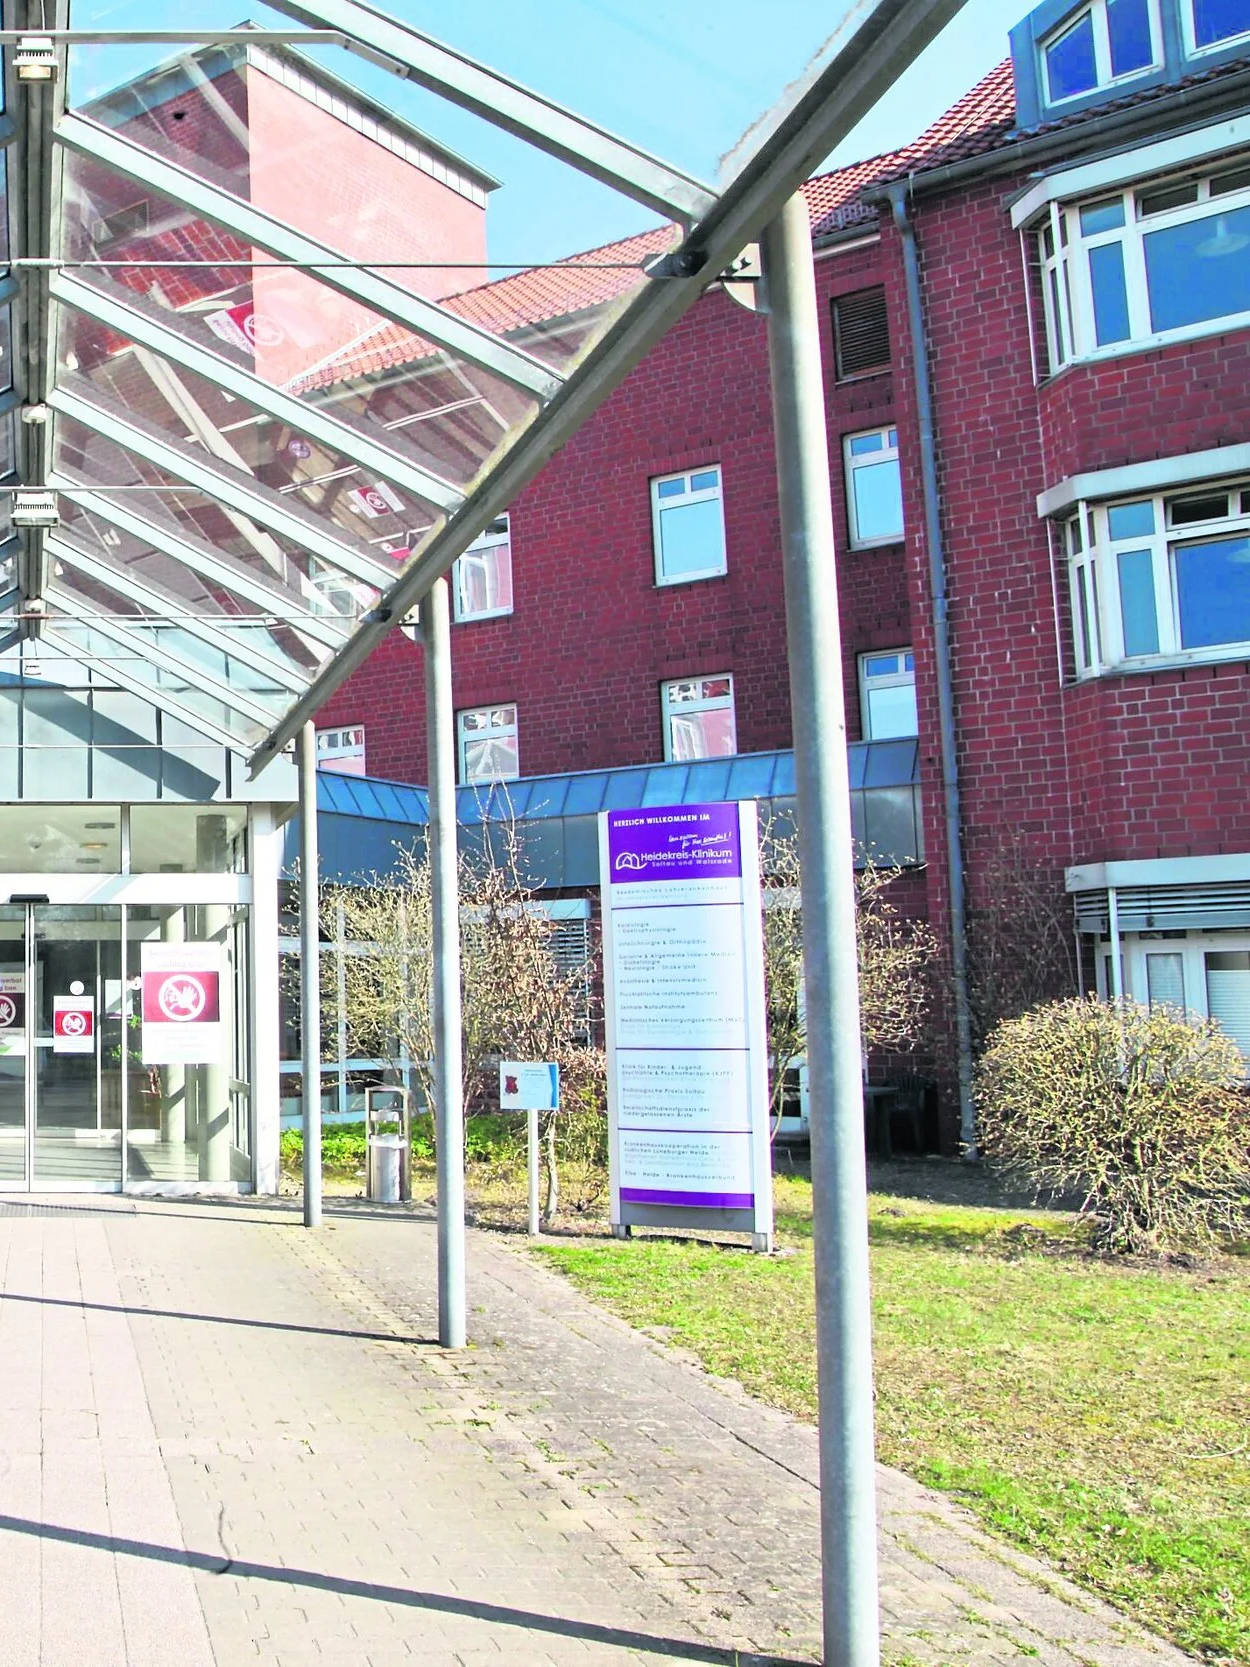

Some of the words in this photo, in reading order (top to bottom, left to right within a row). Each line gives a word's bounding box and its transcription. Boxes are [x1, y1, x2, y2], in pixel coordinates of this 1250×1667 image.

[613, 818, 644, 828] HERZLICH
[646, 814, 697, 824] WILLKOMMEN
[699, 813, 710, 821] IM
[640, 848, 732, 861] Heidekreis-Klinikum
